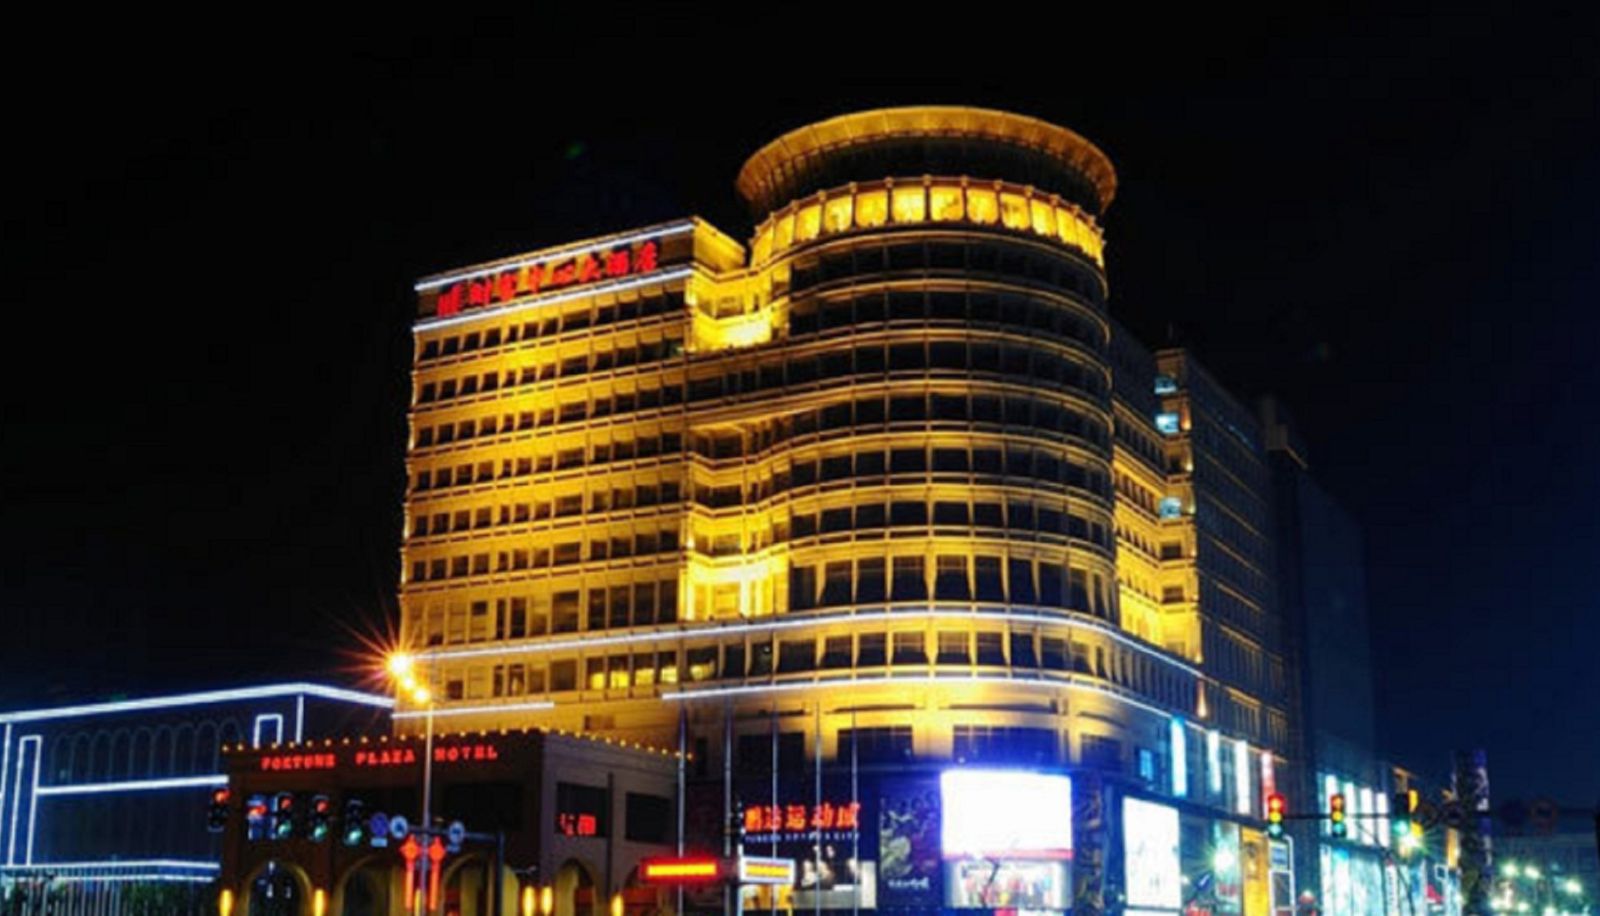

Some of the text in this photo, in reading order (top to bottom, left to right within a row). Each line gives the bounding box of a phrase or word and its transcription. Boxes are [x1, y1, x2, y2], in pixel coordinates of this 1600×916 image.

[260, 744, 497, 770] FORTUNE PLAZA HOTEL
